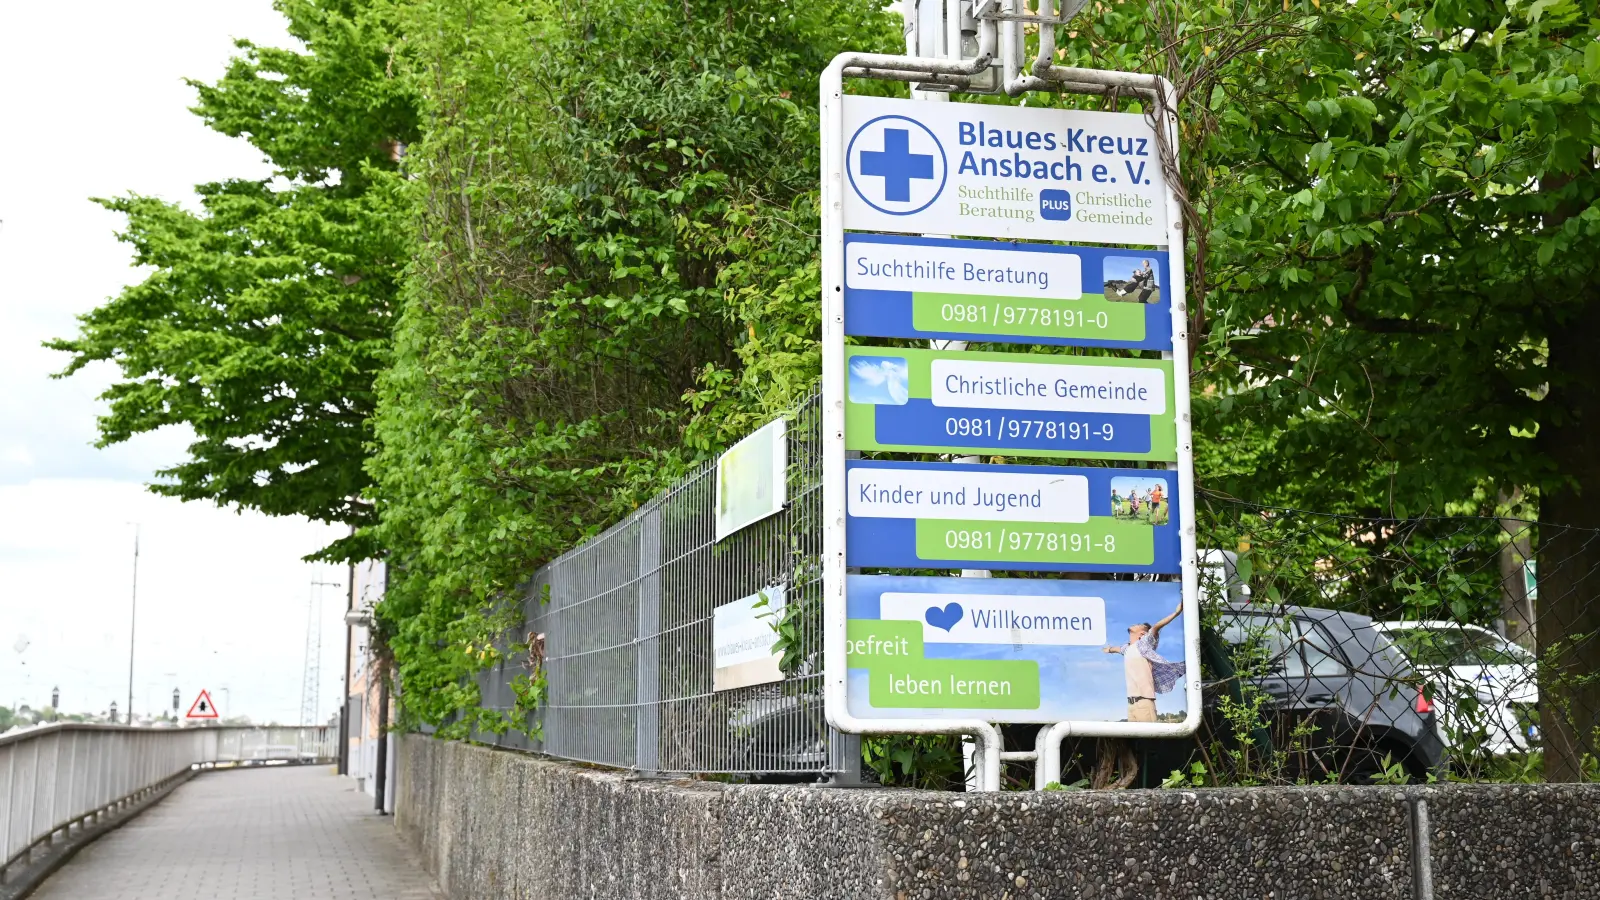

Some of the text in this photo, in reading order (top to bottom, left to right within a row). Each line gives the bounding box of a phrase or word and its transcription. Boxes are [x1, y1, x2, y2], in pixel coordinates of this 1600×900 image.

[958, 121, 1149, 156] Blaues Kreuz
[958, 151, 1151, 186] Ansbach e. V.
[958, 185, 1034, 202] Suchthilfe
[1042, 199, 1069, 211] PLUS
[1075, 192, 1152, 209] Christliche
[958, 203, 1035, 222] Beratung
[1075, 210, 1153, 226] Gemeinde
[857, 257, 1049, 290] Suchthilfe Beratung
[945, 374, 1148, 401] Christliche Gemeinde
[860, 483, 1041, 512] Kinder und Jugend
[971, 608, 1092, 631] Willkommen
[889, 673, 1011, 696] leben lernen
